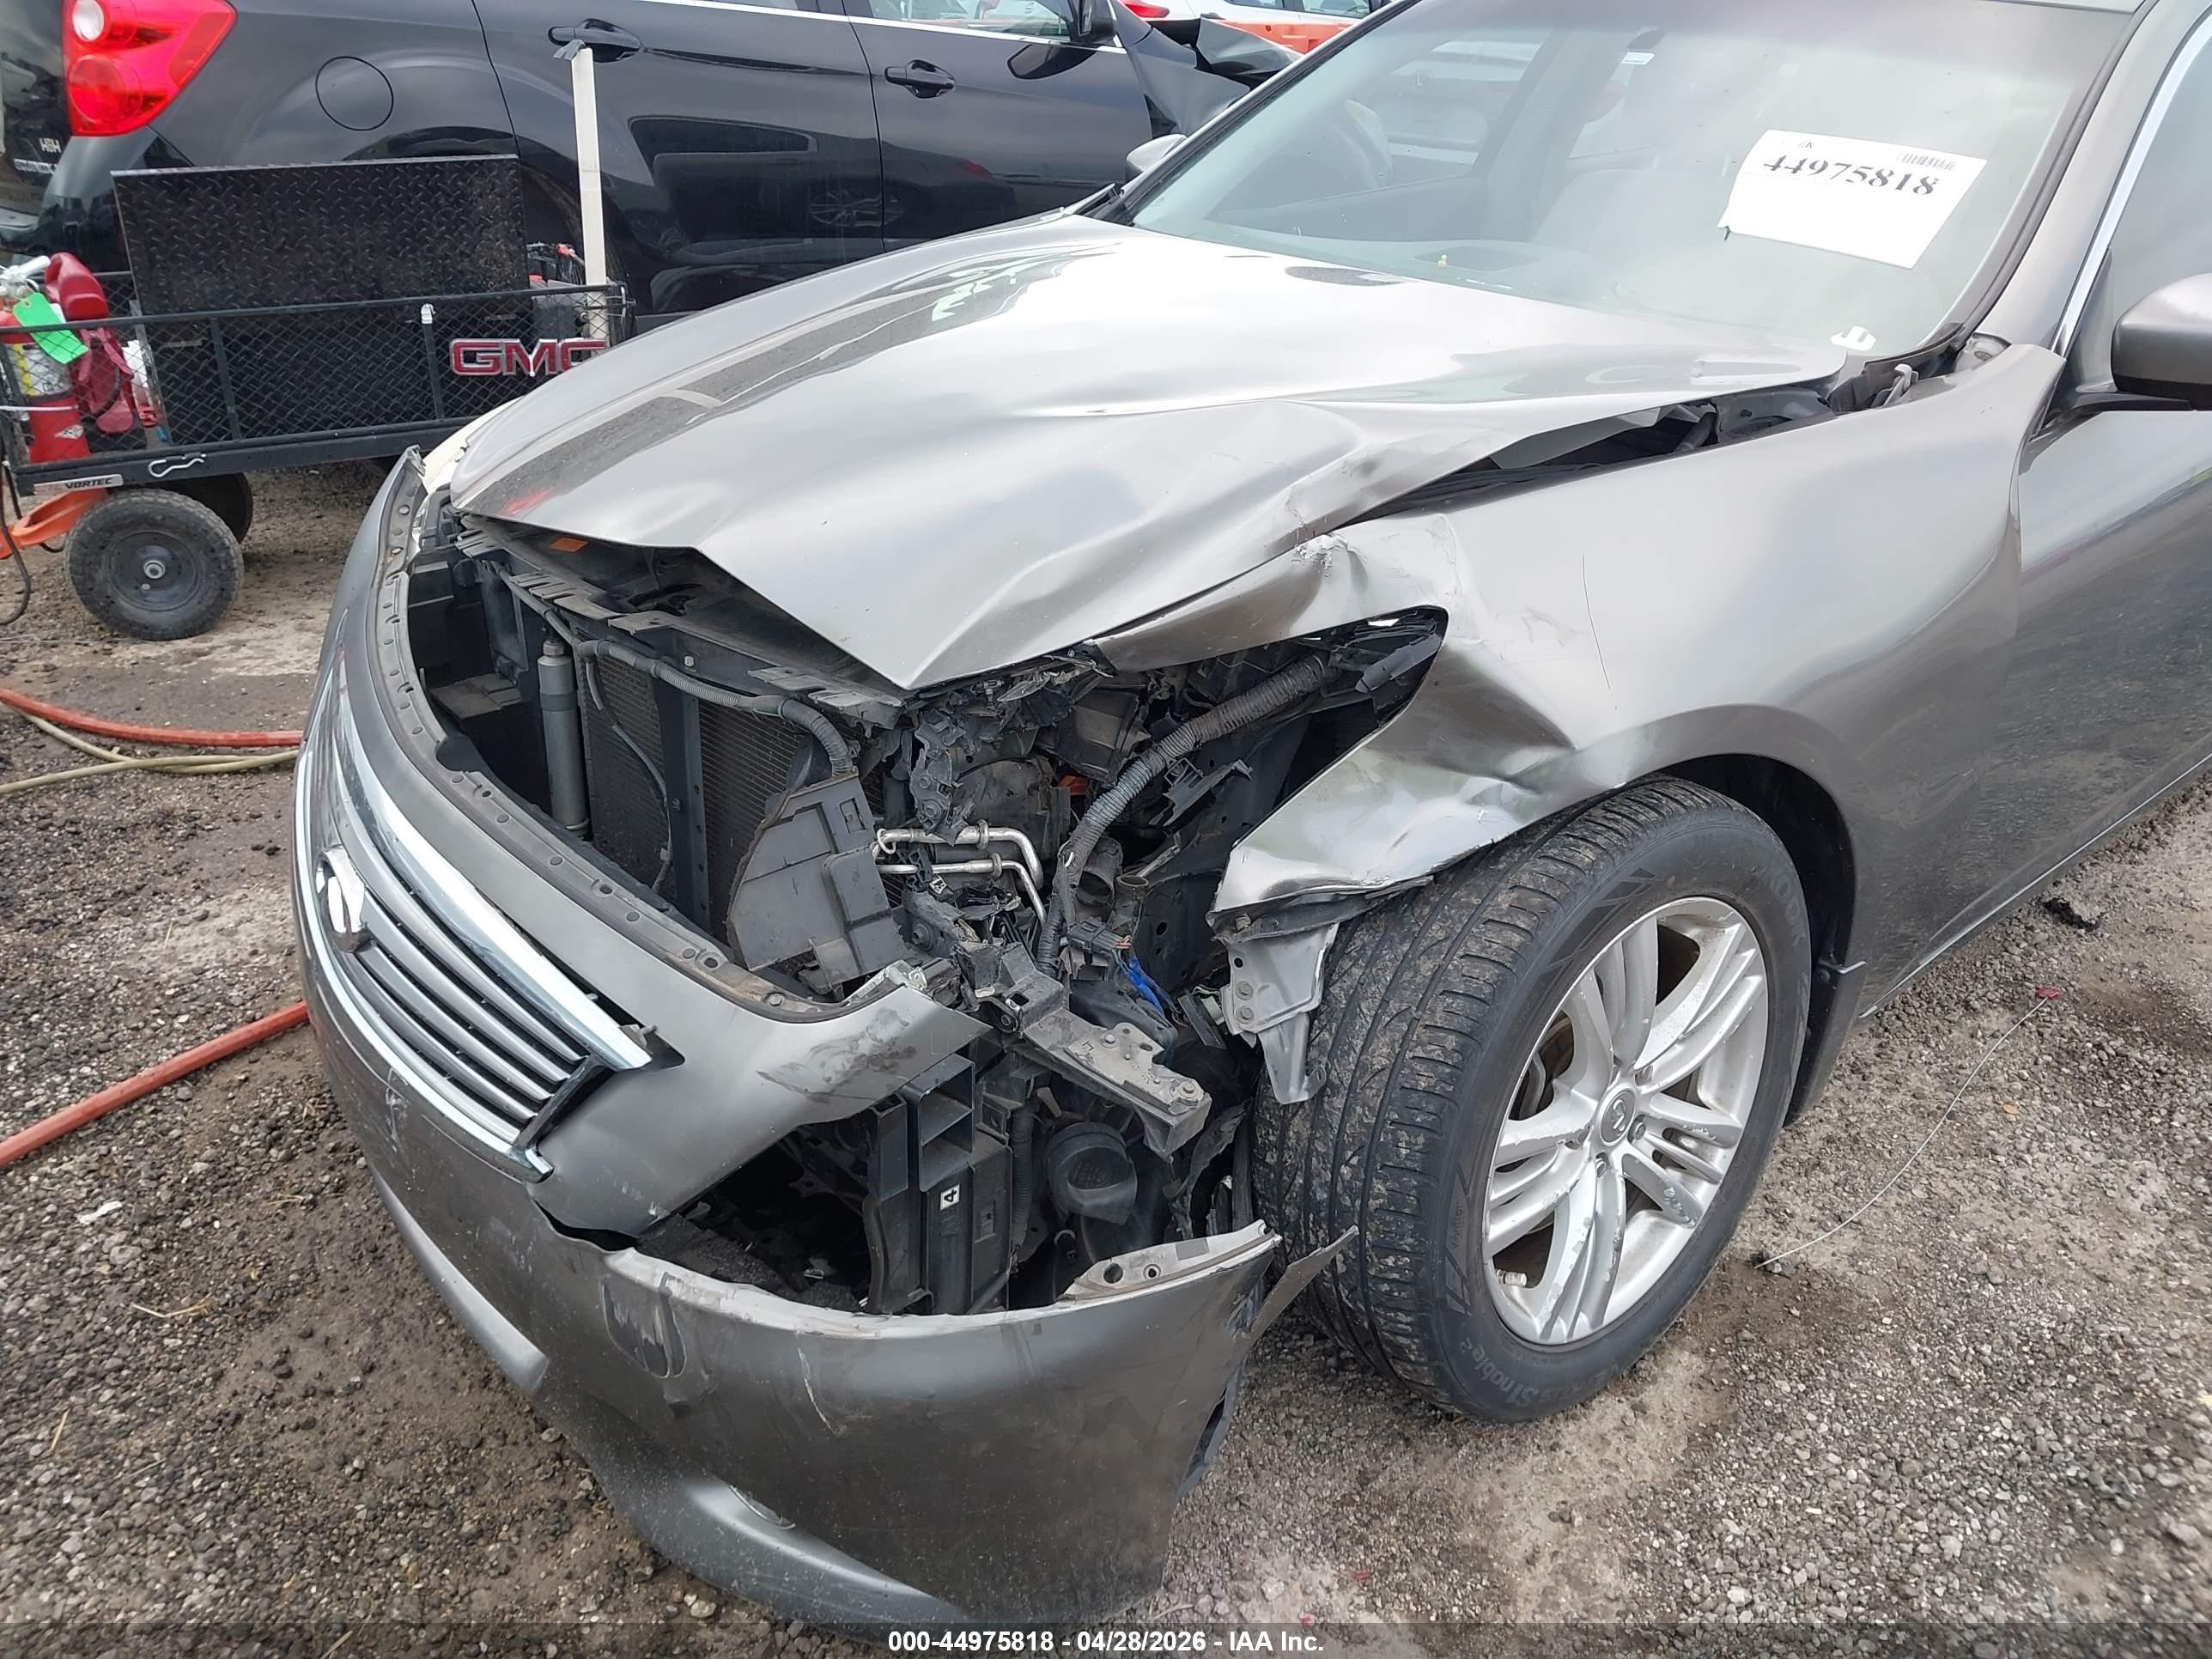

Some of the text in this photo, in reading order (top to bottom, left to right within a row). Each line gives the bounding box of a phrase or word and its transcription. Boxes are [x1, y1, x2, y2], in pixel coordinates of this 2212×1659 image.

[1763, 155, 1939, 195] 44975818
[449, 337, 606, 377] GMC
[64, 477, 113, 489] VORTEC
